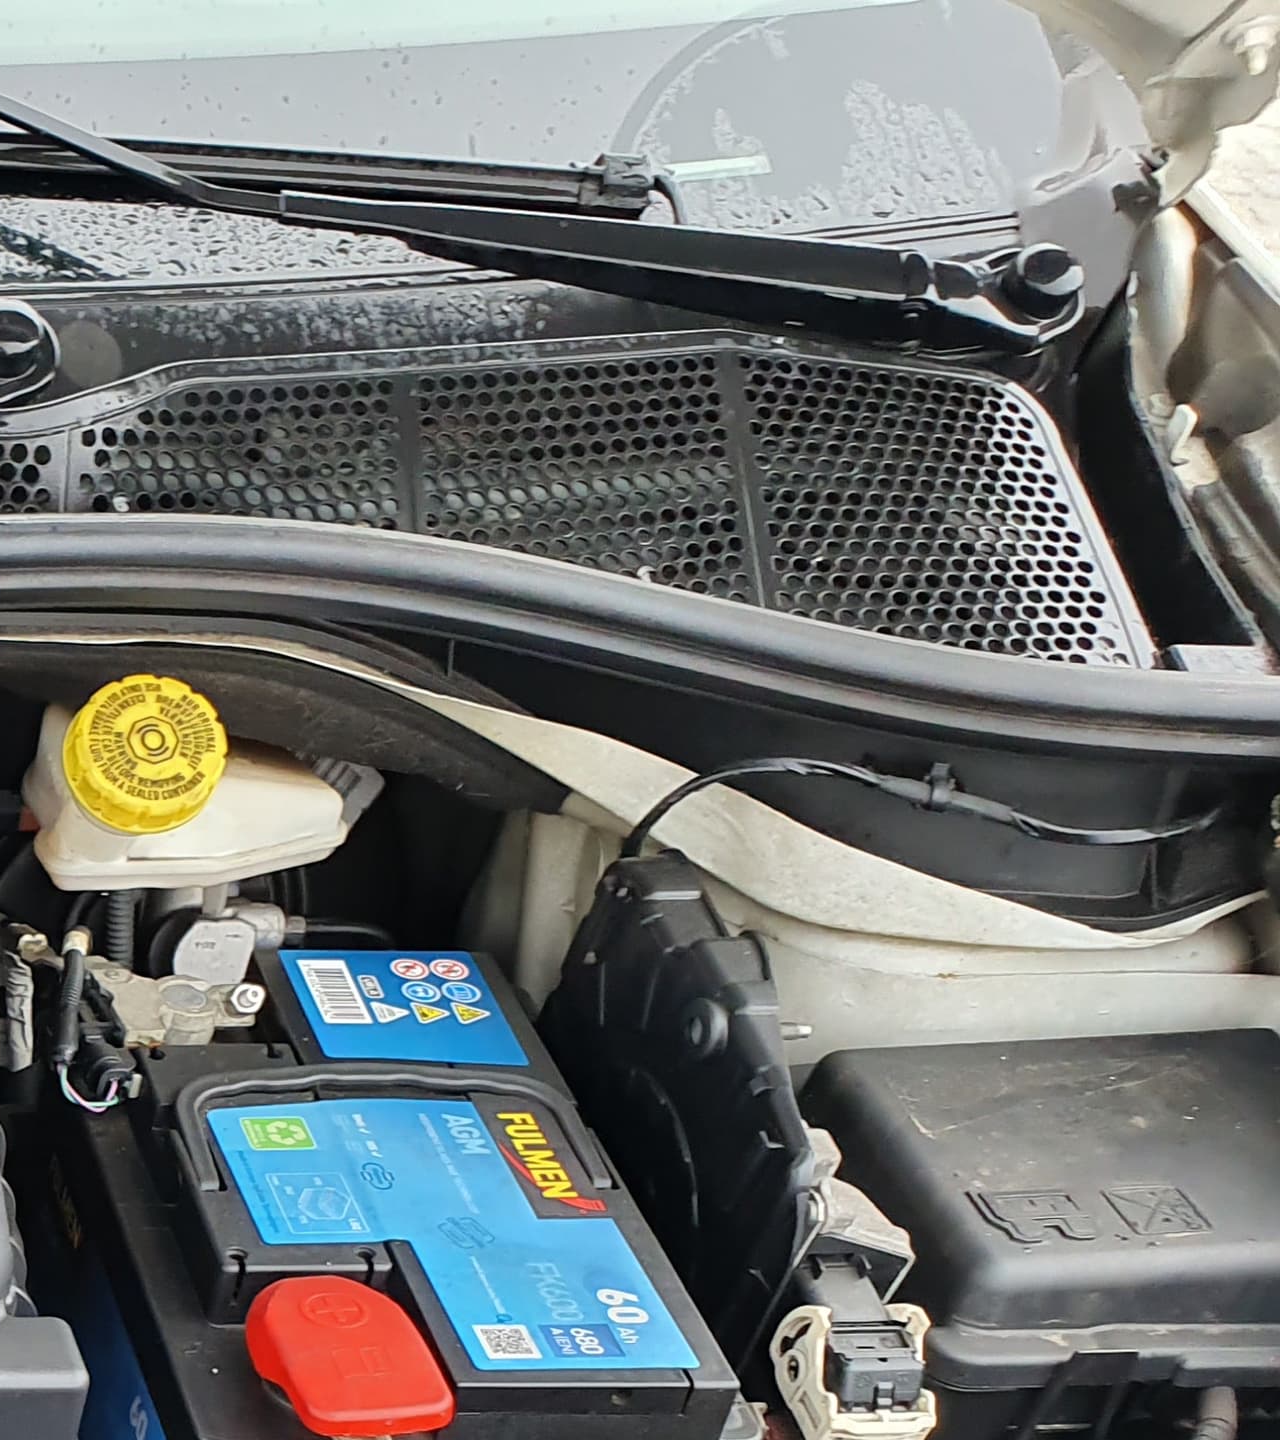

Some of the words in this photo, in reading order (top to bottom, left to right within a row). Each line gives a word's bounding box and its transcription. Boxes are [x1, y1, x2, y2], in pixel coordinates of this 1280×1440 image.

[196, 711, 216, 753] ORIGINAL
[125, 783, 160, 801] SEALED
[441, 1113, 491, 1156] AGM
[496, 1111, 579, 1199] FULMEN
[526, 1262, 585, 1322] FK600
[595, 1287, 650, 1325] 60
[569, 1326, 606, 1356] 680
[616, 1326, 641, 1345] Ah
